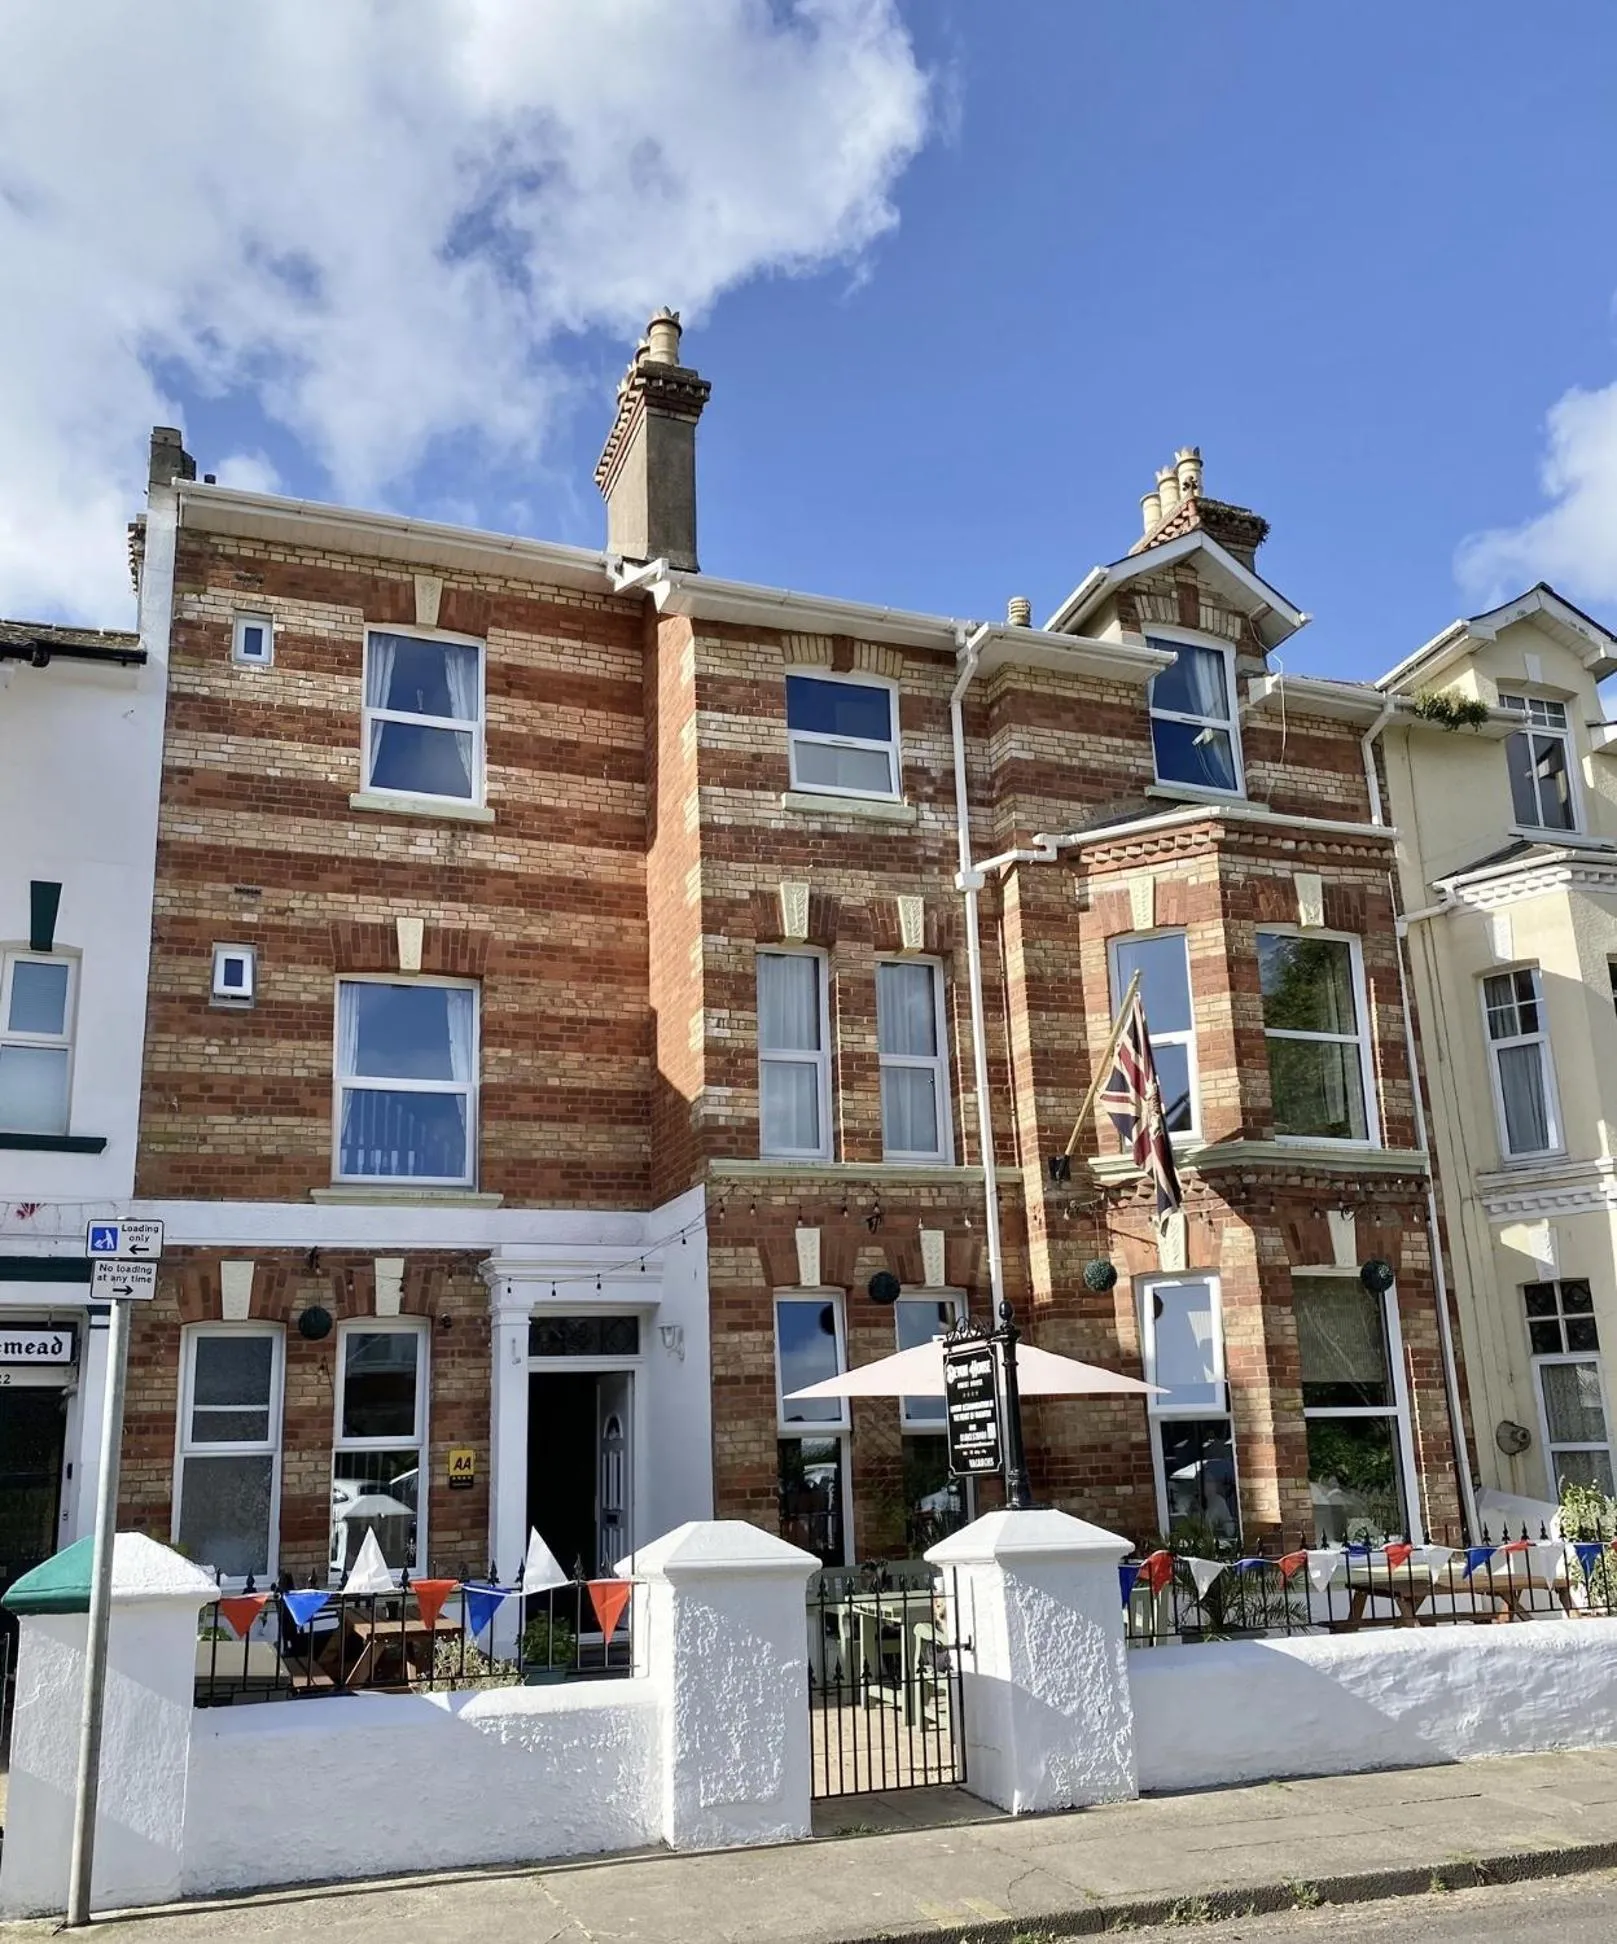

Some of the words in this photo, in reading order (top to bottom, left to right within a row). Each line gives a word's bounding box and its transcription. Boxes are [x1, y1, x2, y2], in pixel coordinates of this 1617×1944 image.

[121, 1224, 159, 1234] Loading
[128, 1234, 150, 1242] only
[99, 1263, 113, 1272] No
[117, 1264, 152, 1275] loading
[96, 1273, 107, 1281] at
[110, 1275, 128, 1284] any
[131, 1275, 153, 1284] time
[0, 1335, 63, 1355] mead
[453, 1456, 471, 1471] AA
